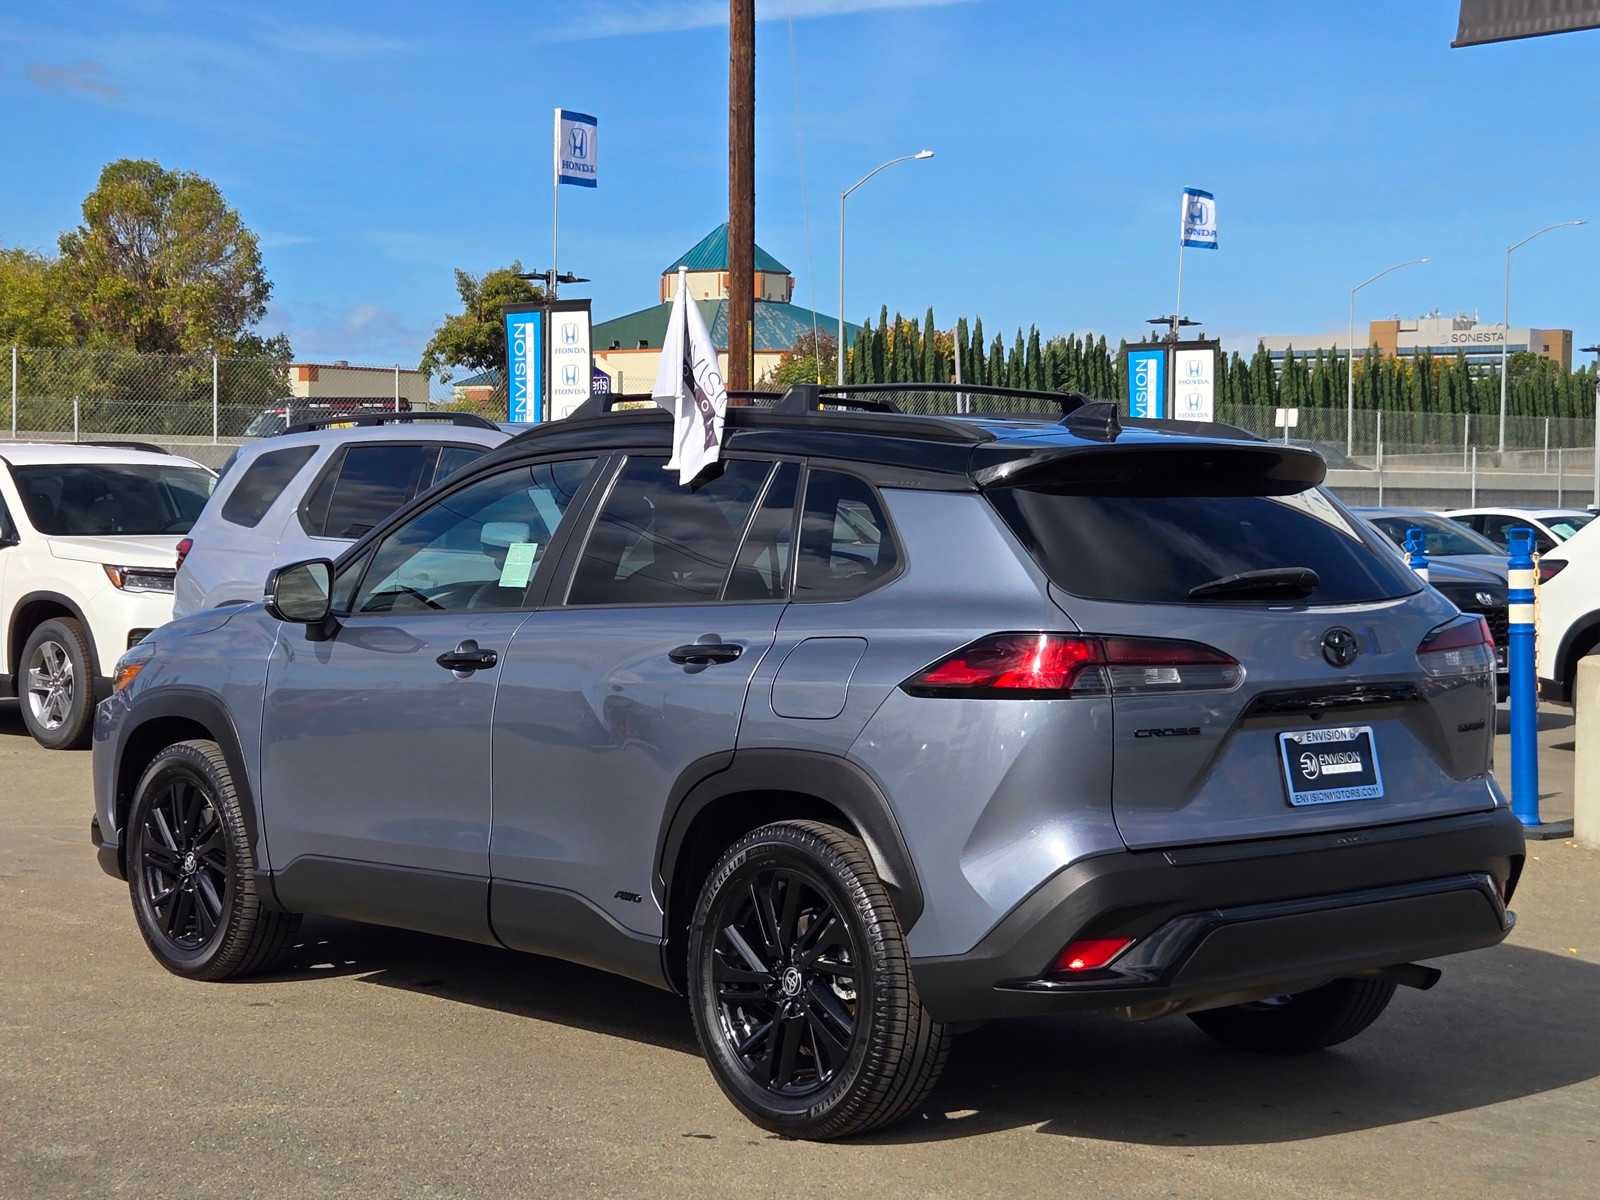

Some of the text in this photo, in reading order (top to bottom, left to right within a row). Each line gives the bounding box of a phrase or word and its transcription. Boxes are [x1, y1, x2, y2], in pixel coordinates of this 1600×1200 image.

[1451, 332, 1504, 343] SONESTA
[514, 323, 526, 422] ENVISION
[555, 388, 586, 396] HONDA
[1136, 359, 1147, 418] VISION
[1306, 730, 1347, 743] ENVISION
[1318, 751, 1361, 766] ENVISION
[1295, 787, 1379, 803] ENVISIONMOTORS.COM
